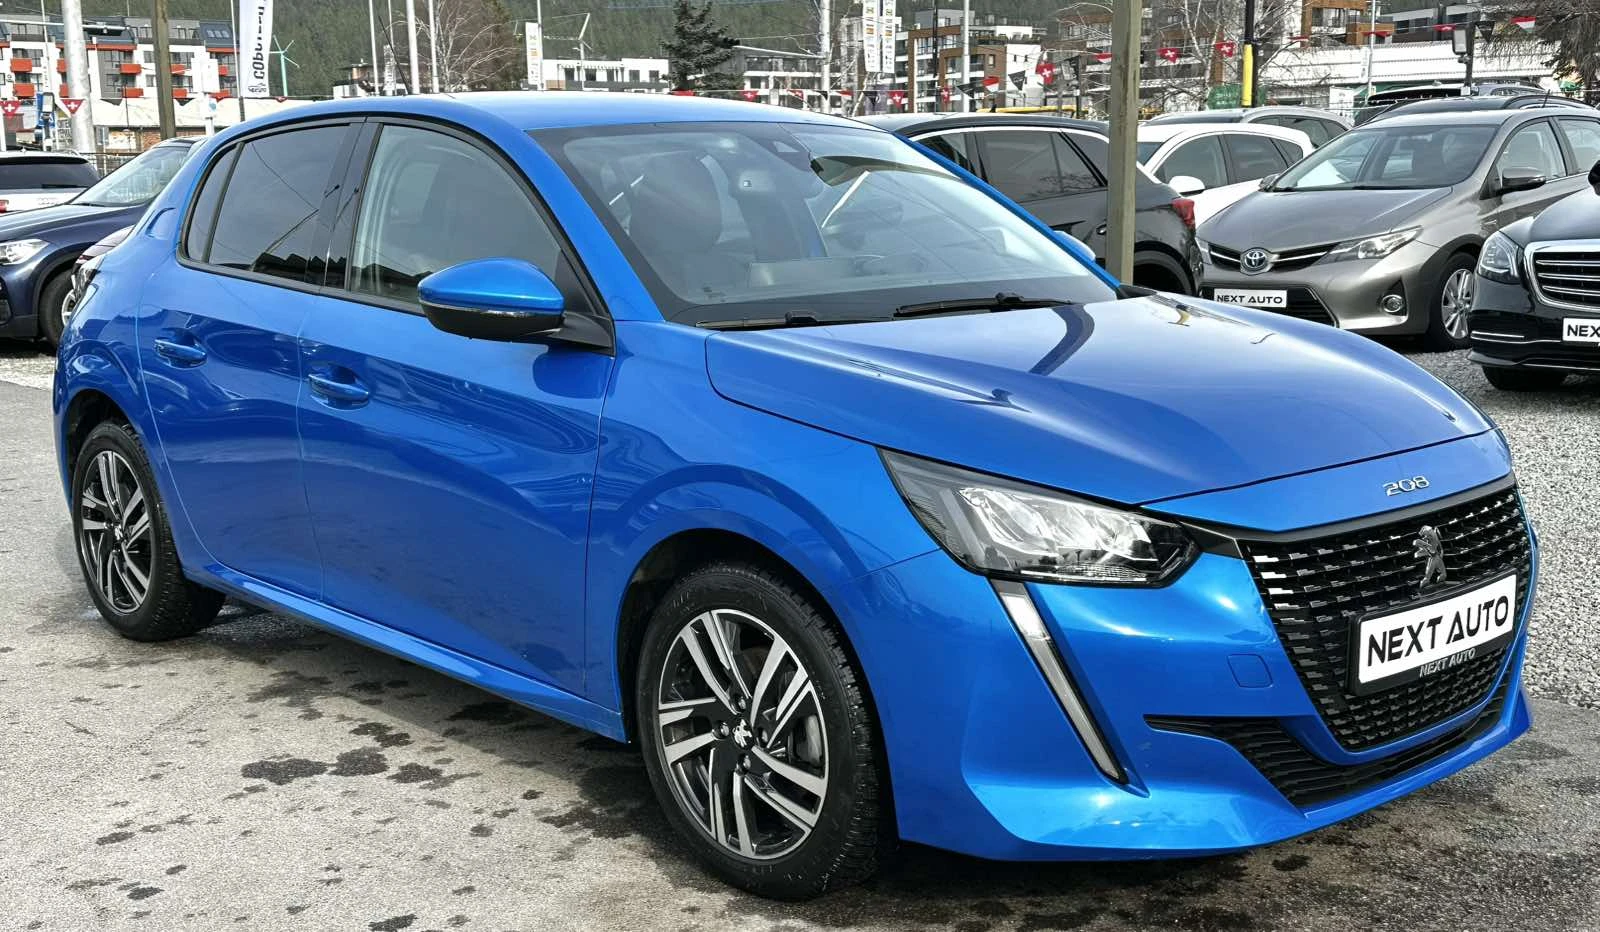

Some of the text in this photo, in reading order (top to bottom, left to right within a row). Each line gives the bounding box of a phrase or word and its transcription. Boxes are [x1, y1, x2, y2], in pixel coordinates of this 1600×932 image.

[1216, 294, 1283, 304] NEXT AUTO
[1382, 475, 1430, 496] 208
[1367, 595, 1509, 667] NEXT AUTO
[1419, 648, 1476, 678] NEXT AUTO
